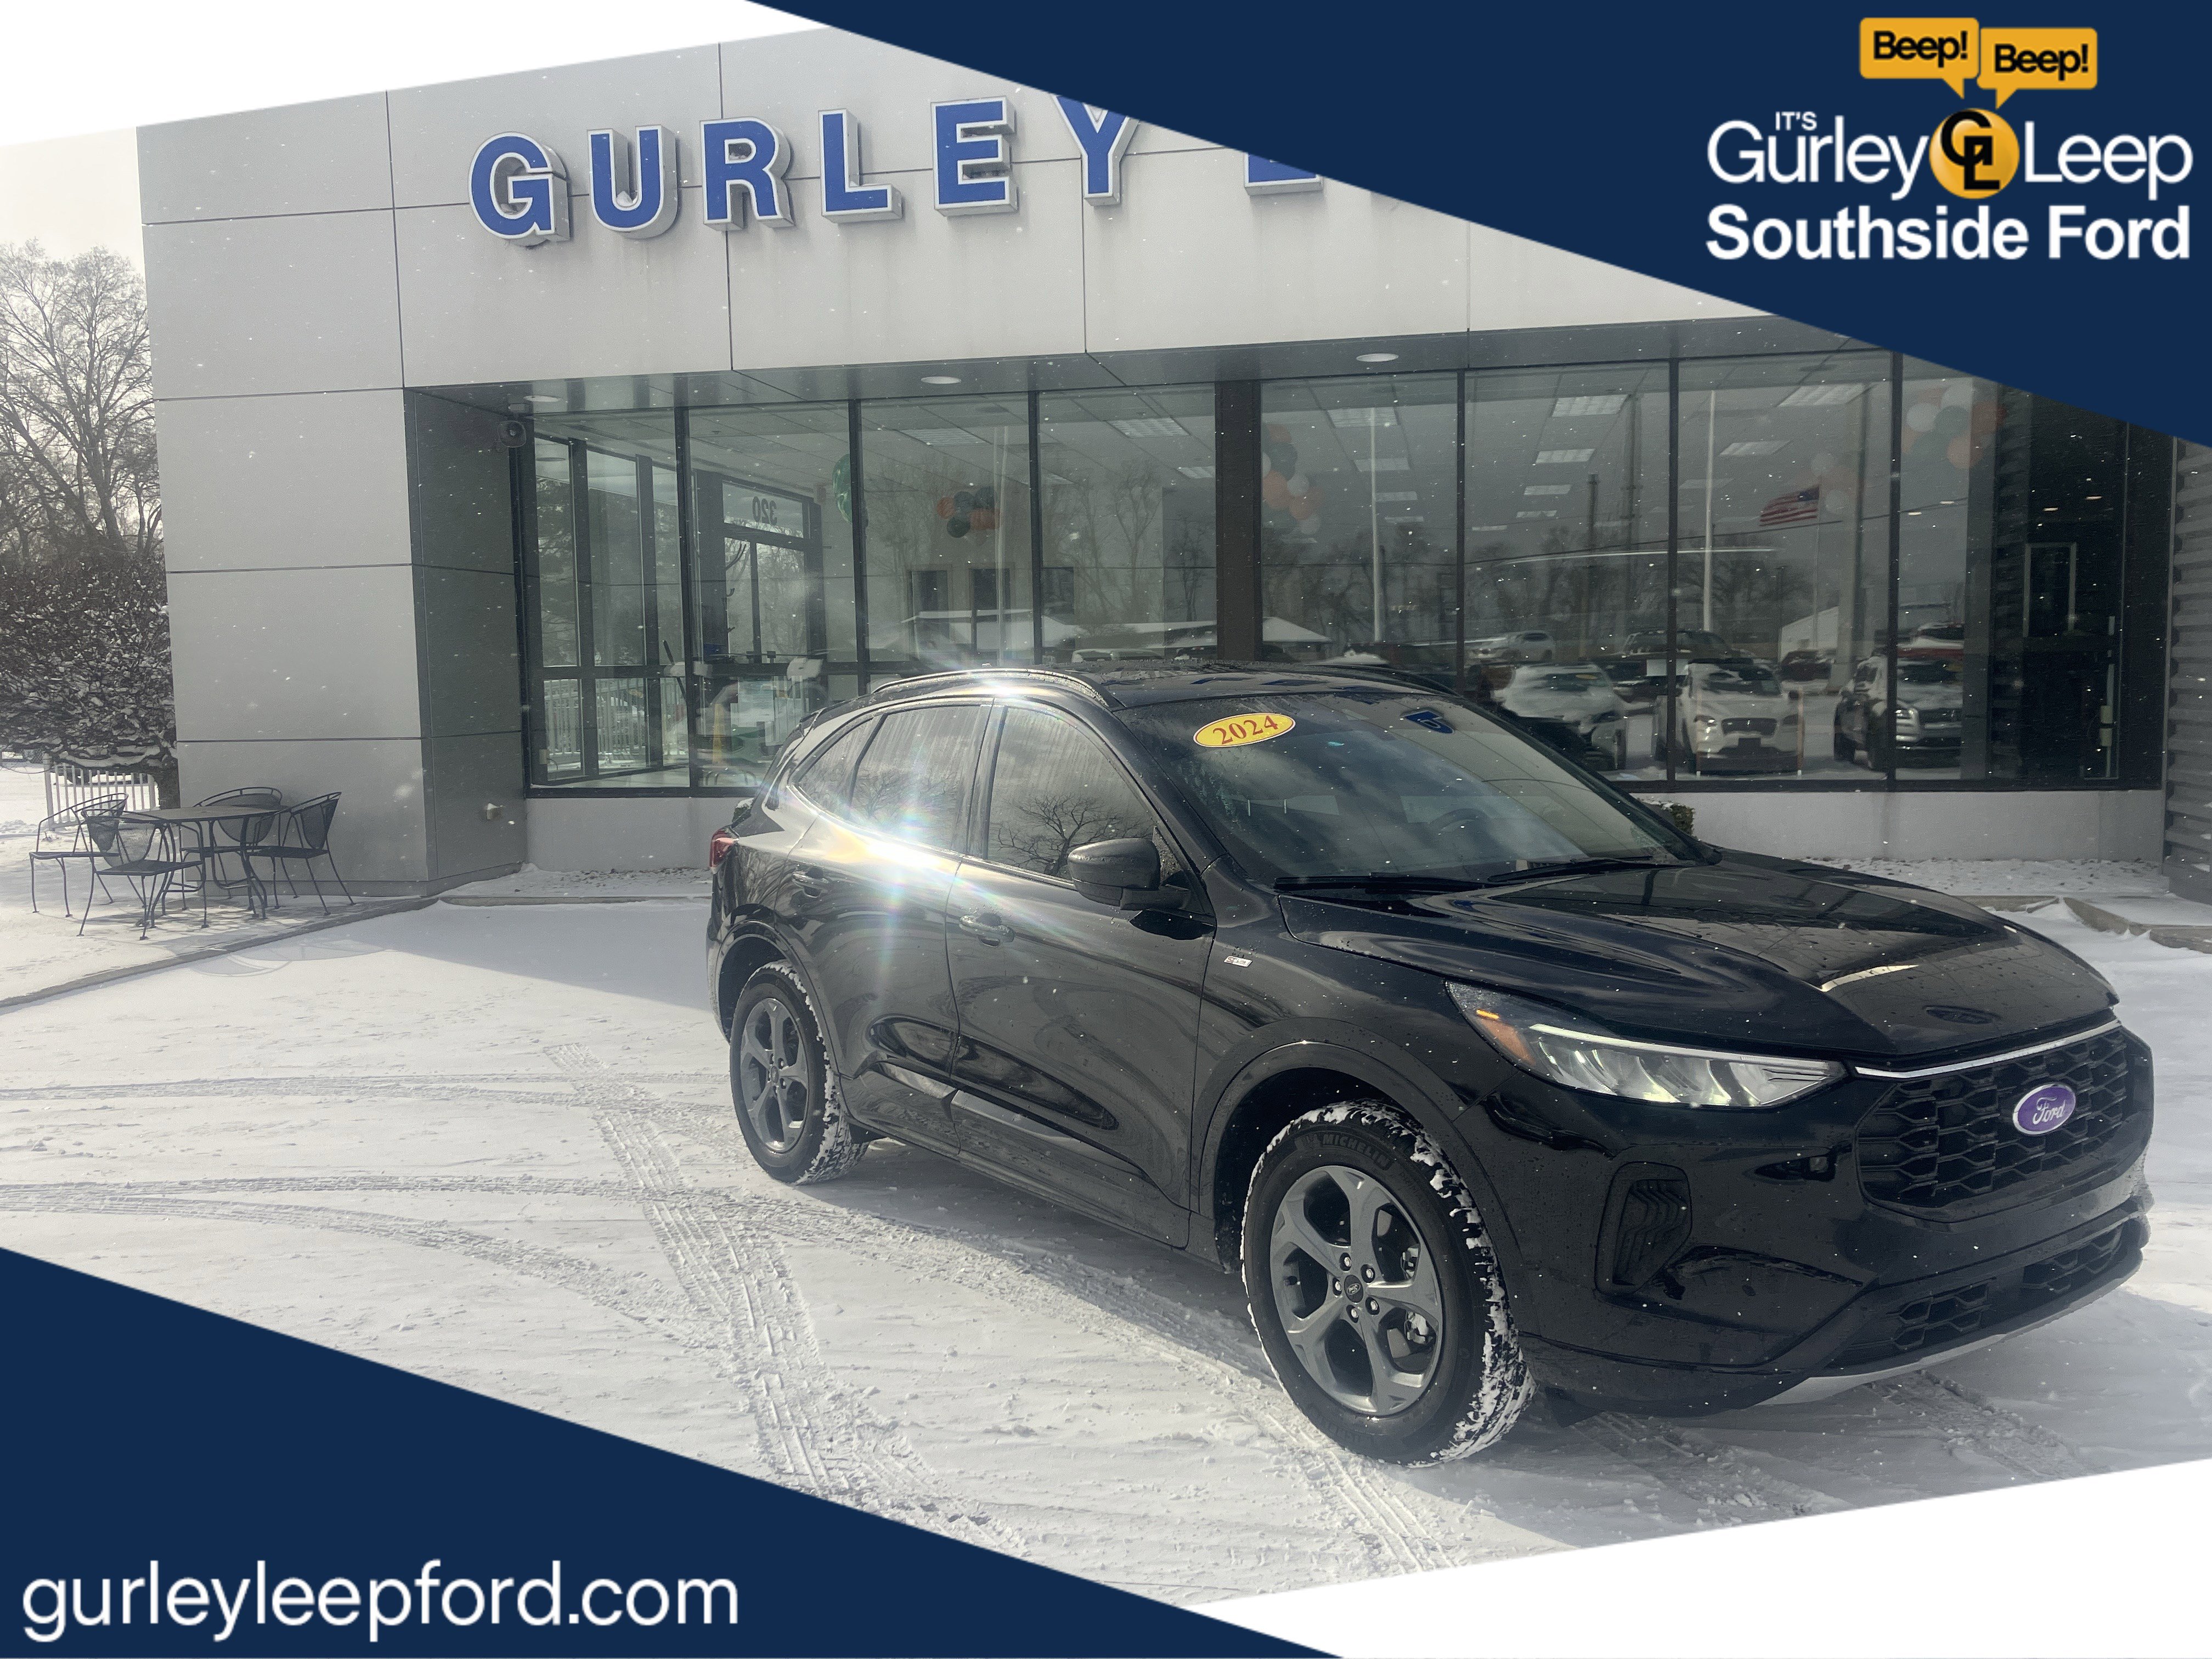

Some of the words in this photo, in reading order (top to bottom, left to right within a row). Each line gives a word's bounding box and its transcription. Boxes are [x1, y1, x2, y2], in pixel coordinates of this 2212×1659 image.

[469, 95, 1139, 242] GURLEY
[1212, 715, 1278, 744] 2024
[2033, 1097, 2067, 1125] Ford
[1323, 1133, 1390, 1167] MICHELIN
